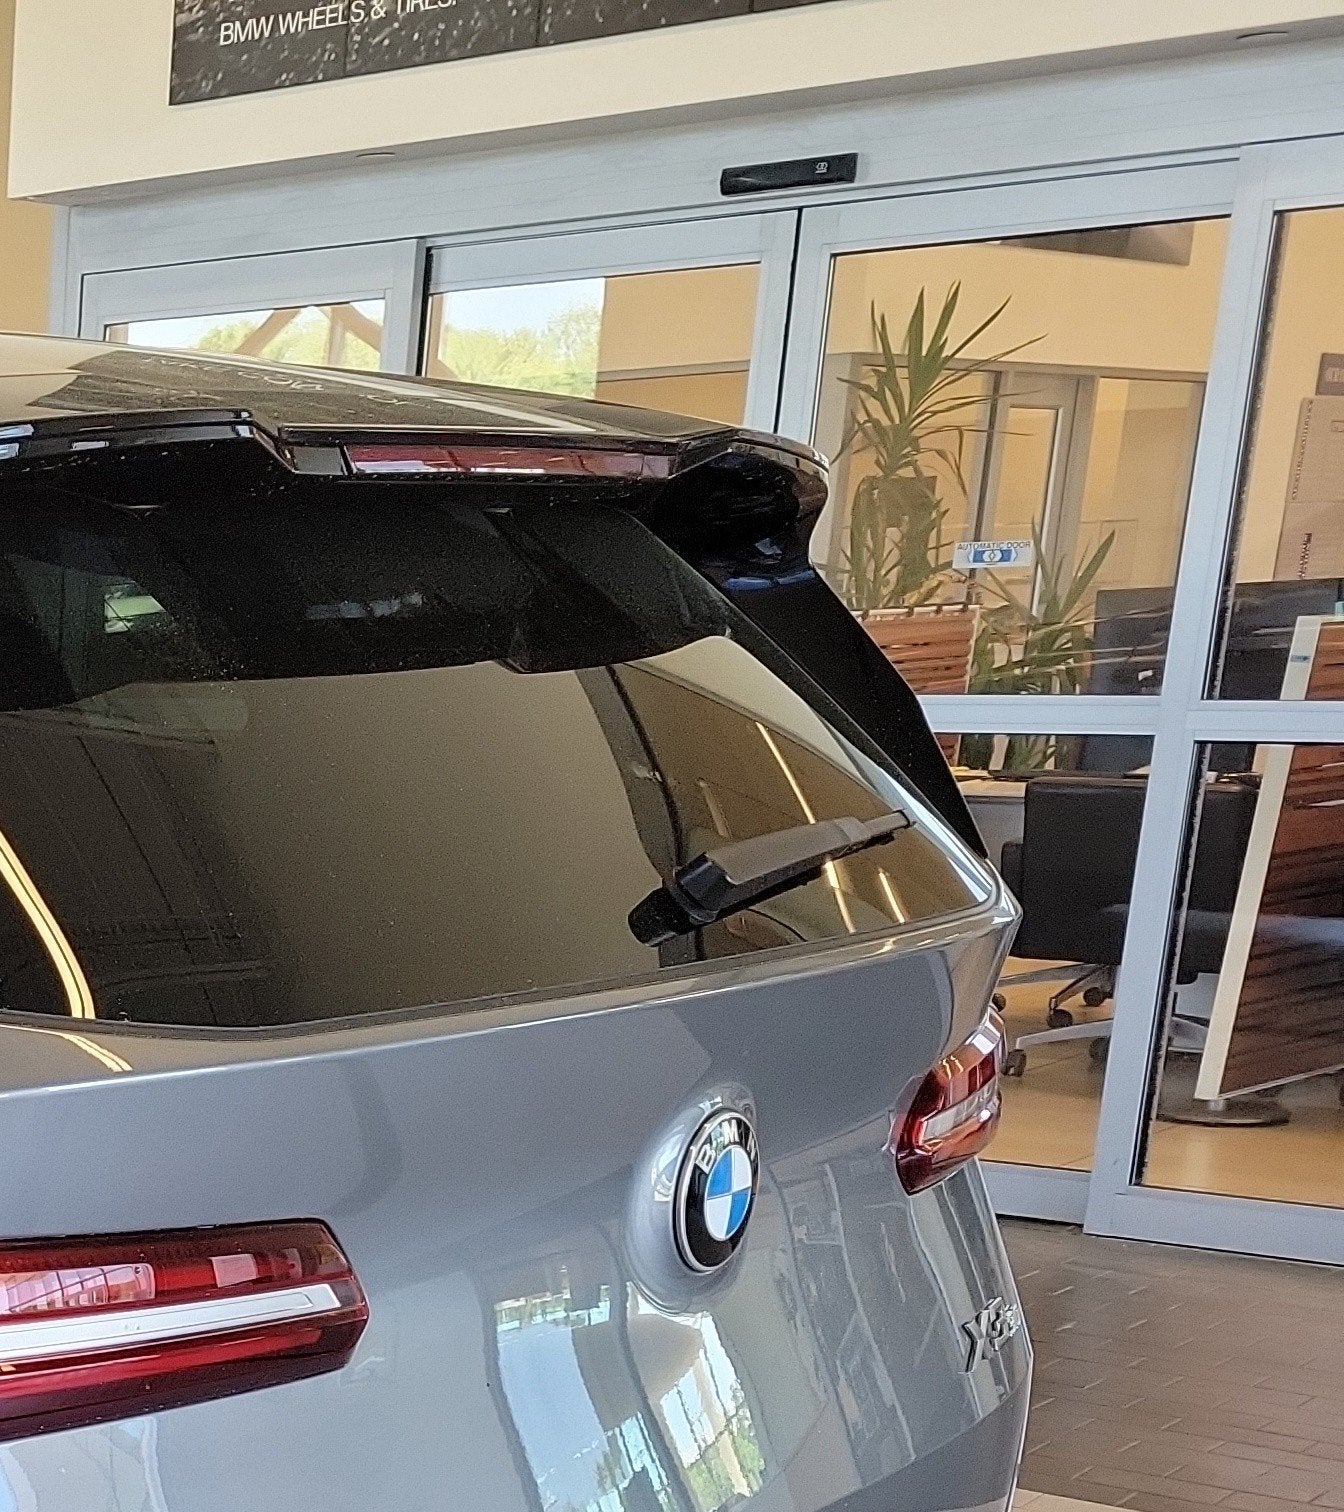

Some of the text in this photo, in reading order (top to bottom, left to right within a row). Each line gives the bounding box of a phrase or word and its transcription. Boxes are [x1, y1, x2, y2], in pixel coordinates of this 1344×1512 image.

[219, 14, 274, 46] BMW
[278, 0, 365, 35] WHEELS
[956, 541, 1005, 551] AUTOMATIC
